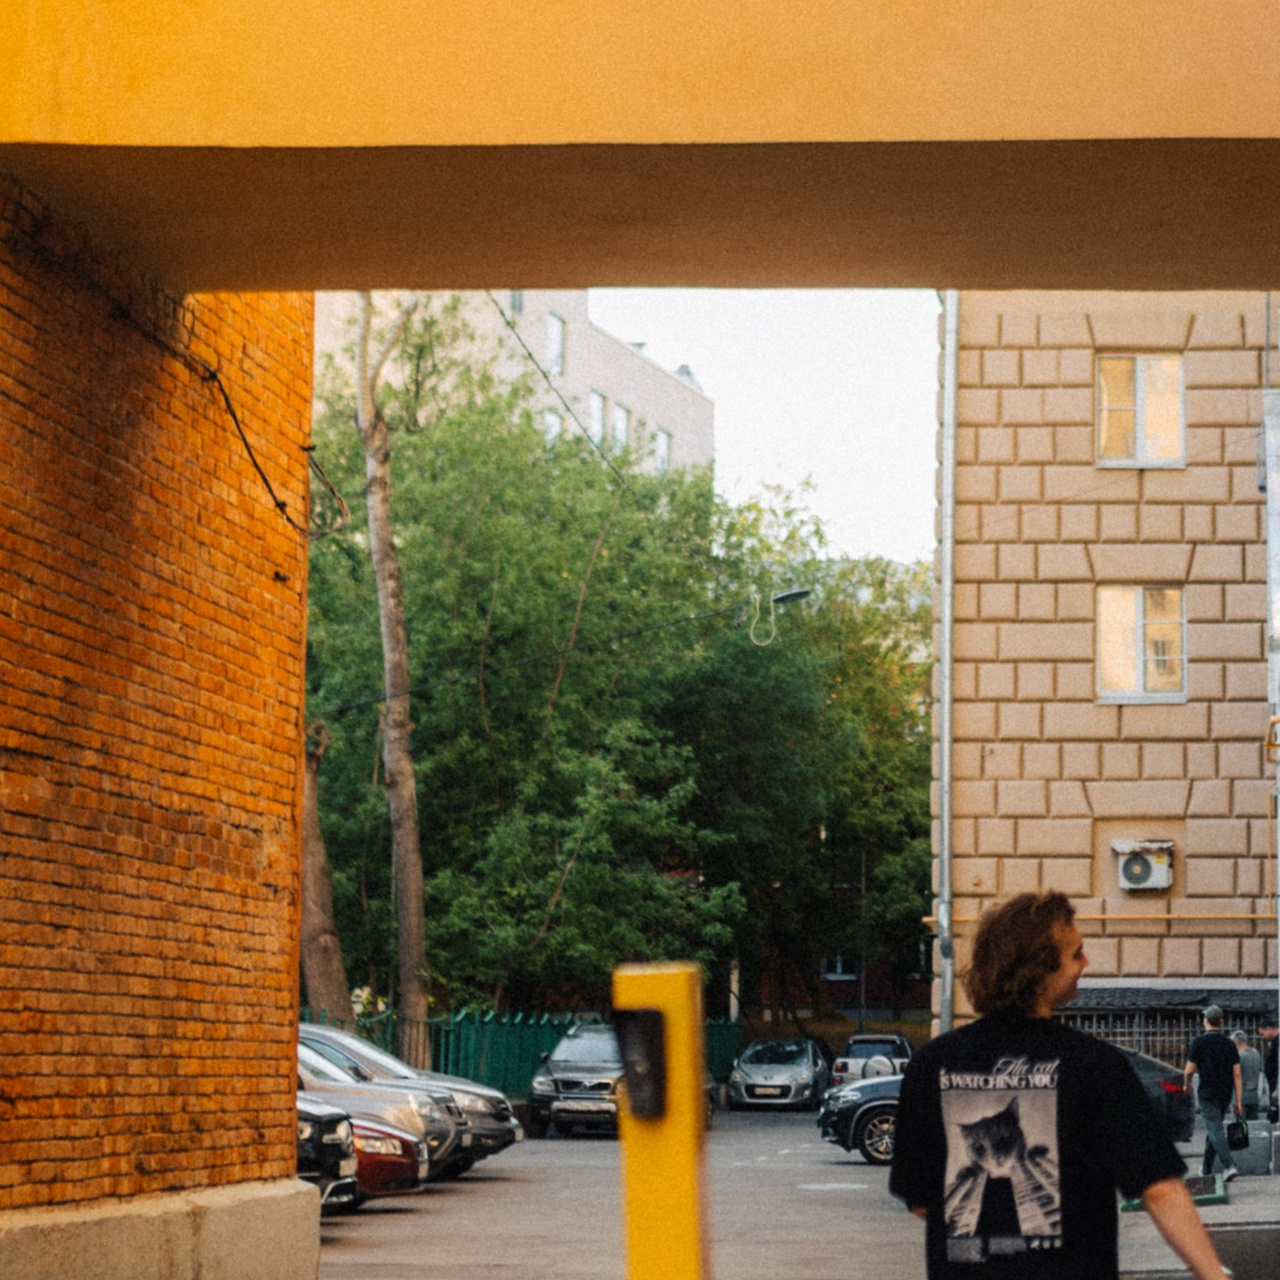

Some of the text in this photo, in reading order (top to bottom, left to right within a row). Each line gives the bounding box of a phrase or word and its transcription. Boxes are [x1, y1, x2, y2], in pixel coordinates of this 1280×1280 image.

[992, 1057, 1061, 1075] The cat
[952, 1074, 1027, 1089] WATCHING
[1028, 1074, 1059, 1089] YOU
